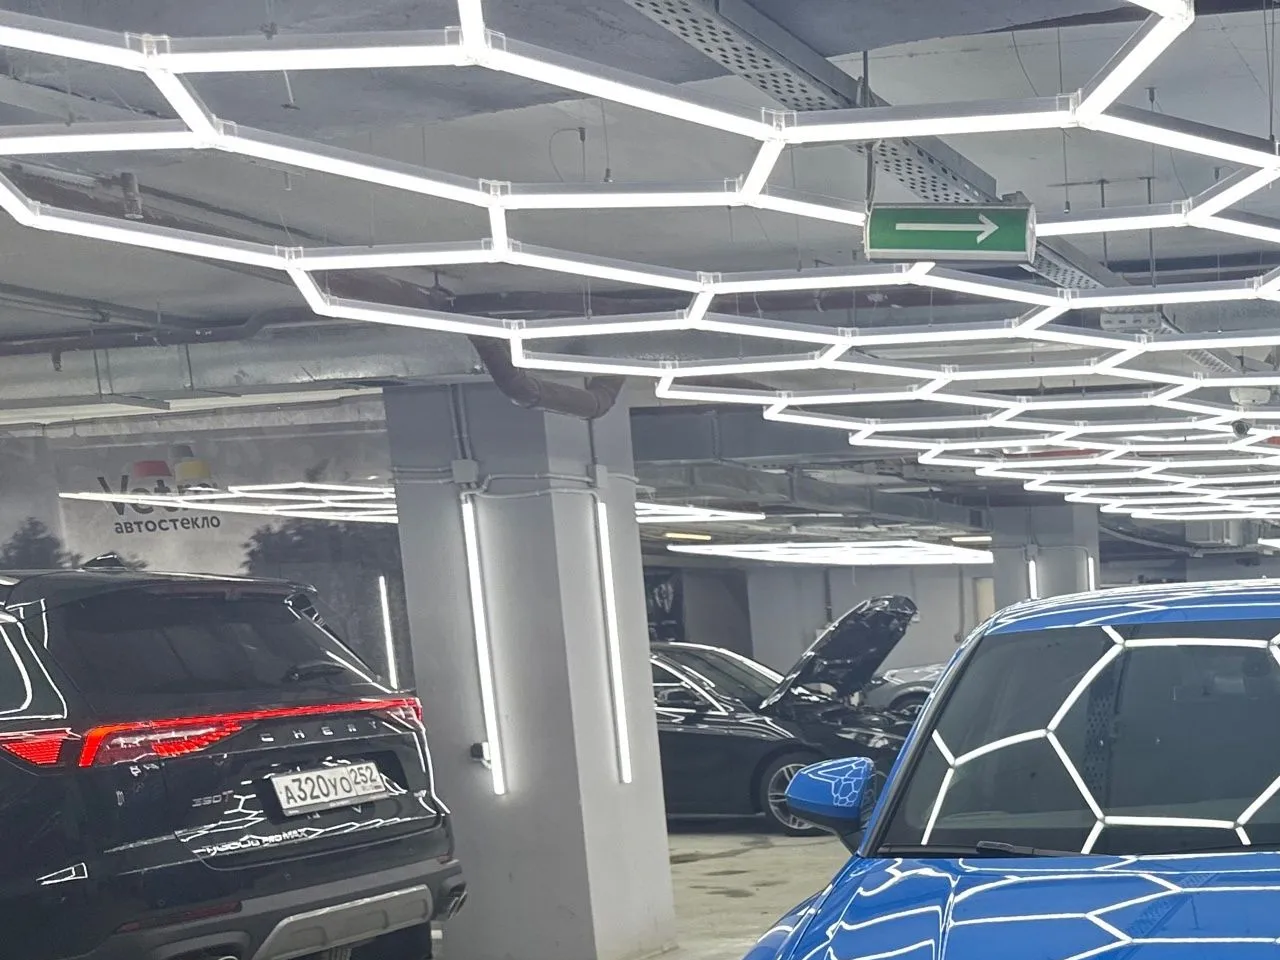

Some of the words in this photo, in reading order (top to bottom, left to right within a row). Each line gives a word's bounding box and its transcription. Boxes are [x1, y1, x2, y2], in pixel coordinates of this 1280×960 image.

[114, 515, 221, 534] автостекло
[260, 721, 378, 742] CHERY
[349, 766, 378, 785] 252
